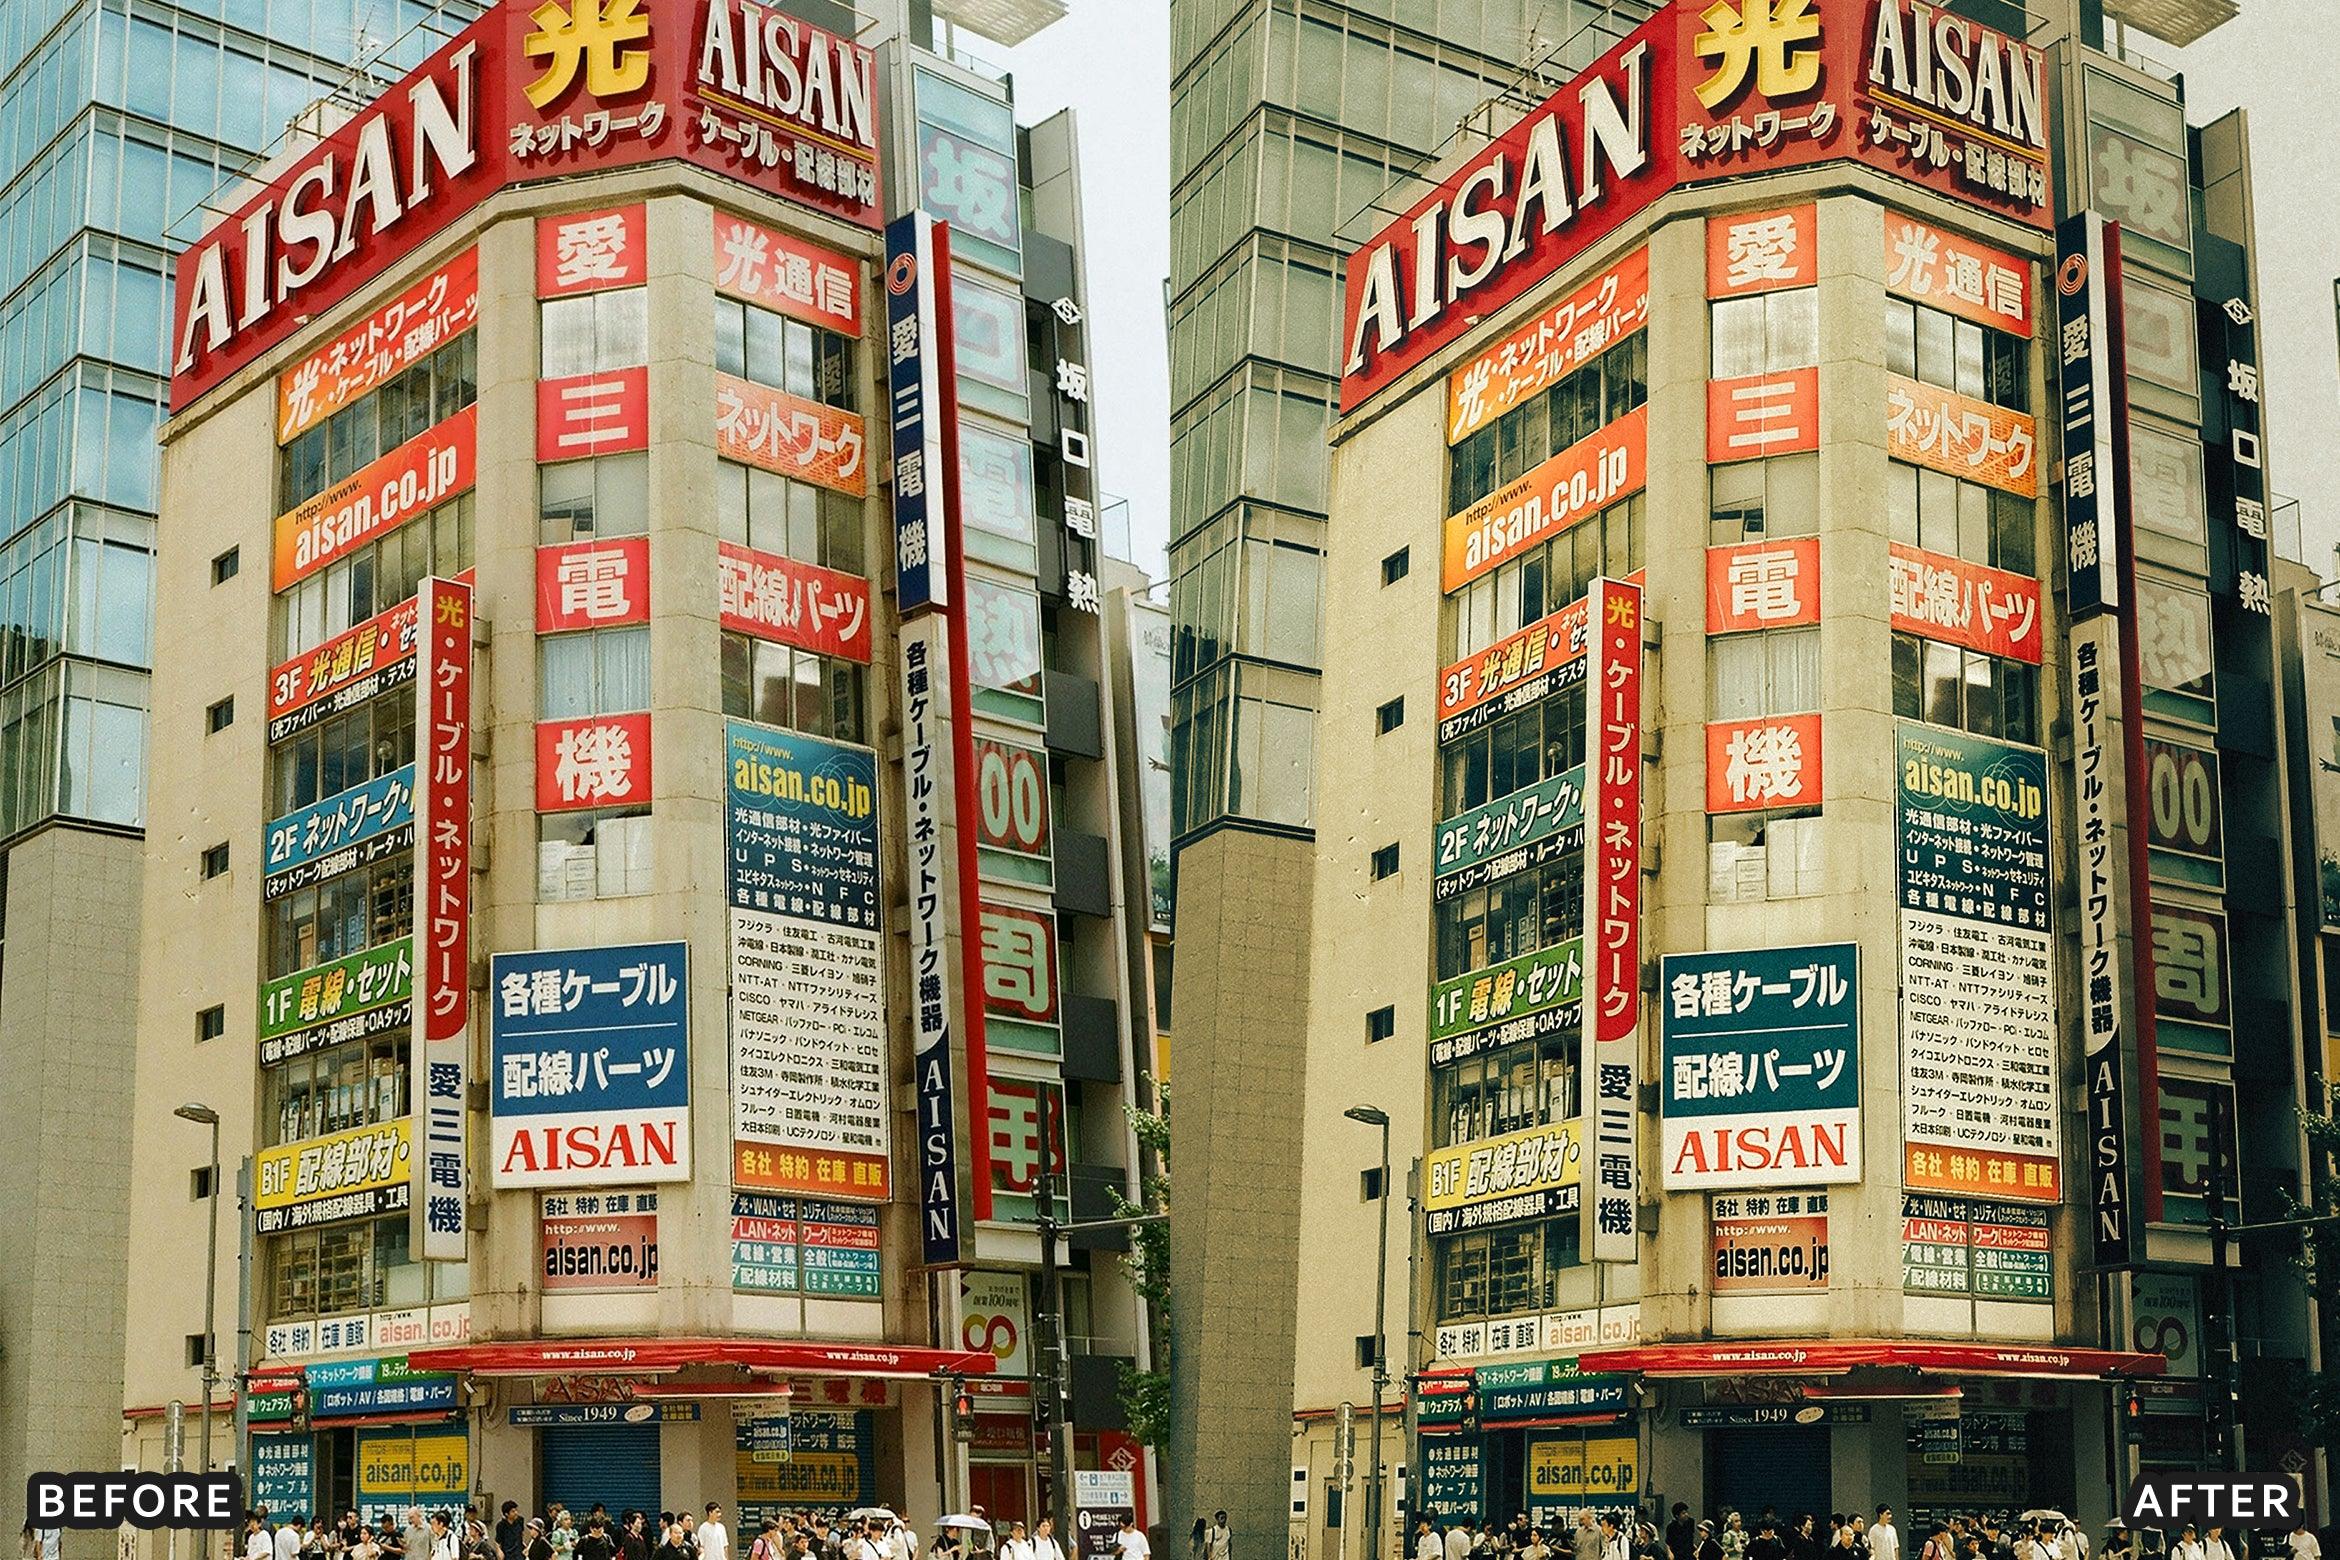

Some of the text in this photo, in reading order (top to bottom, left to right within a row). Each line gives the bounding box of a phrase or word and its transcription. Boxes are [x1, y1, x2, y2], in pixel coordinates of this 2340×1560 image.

[523, 0, 650, 110] 光
[699, 0, 877, 149] AISAN
[1694, 0, 1821, 110] 光
[1870, 0, 2048, 149] AISAN
[509, 101, 666, 158] ネットワーク
[1680, 101, 1837, 158] ネットワーク
[175, 39, 478, 378] AISAN
[927, 136, 1011, 239] 坂
[1345, 39, 1648, 378] AISAN
[2098, 136, 2182, 239] 坂
[719, 224, 853, 321] 光通信
[1889, 224, 2023, 321] 光通信
[716, 388, 862, 478] ネットワーク
[892, 313, 926, 572] 愛三電機
[1887, 389, 2033, 479] ネットワーク
[2063, 314, 2097, 573] 愛三電機
[295, 479, 362, 525] http://www.
[295, 445, 458, 570] aisan.co.jp
[555, 214, 632, 801] 愛 三 電 機
[1056, 358, 1100, 616] 坂口電熱
[1465, 446, 1628, 571] aisan.co.jp
[1725, 214, 1802, 802] 愛 三 電 機
[2227, 359, 2271, 617] 坂口電熱
[718, 555, 864, 642] 配線パーツ
[1889, 556, 2035, 643] 配線パーツ
[273, 666, 303, 706] 3F
[1443, 667, 1473, 707] 3F
[432, 595, 466, 1016] 光・ケーブル・ネットワーク
[734, 755, 871, 818] aisan.co.jp
[1905, 756, 2042, 819] aisan.co.jp
[269, 823, 298, 864] 2F
[906, 640, 942, 1034] 各種ケーブル・ネットワーク機器
[1439, 824, 1468, 865] 2F
[266, 988, 293, 1026] 1F
[501, 962, 678, 1018] 各種ケーブル
[1436, 989, 1463, 1027] 1F
[1672, 963, 1849, 1019] 各種ケーブル
[502, 1047, 676, 1099] 配線パーツ
[1672, 1048, 1846, 1100] 配線パーツ
[260, 1156, 291, 1197] B1F
[428, 1062, 463, 1234] 愛三電機
[501, 1121, 678, 1173] AISAN
[742, 1150, 882, 1187] 各社 特約 在庫 直販
[922, 1059, 950, 1242] AISAN
[1430, 1157, 1461, 1198] B1F
[1598, 1063, 1633, 1235] 愛三電機
[1671, 1122, 1848, 1174] AISAN
[2093, 1060, 2121, 1243] AISAN
[545, 1223, 622, 1237] http://www.
[1715, 1224, 1792, 1238] http://www.
[542, 1348, 637, 1361] www.aisan.co.jp
[826, 1351, 900, 1364] www.aisan.co.jp
[1712, 1350, 1807, 1363] www.aisan.co.jp
[1997, 1353, 2071, 1366] www.aisan.co.jp
[558, 1412, 583, 1423] Since
[582, 1406, 618, 1421] 1949
[1729, 1414, 1754, 1425] Since
[1752, 1408, 1788, 1423] 1949
[366, 1455, 462, 1489] aisan.co.jp
